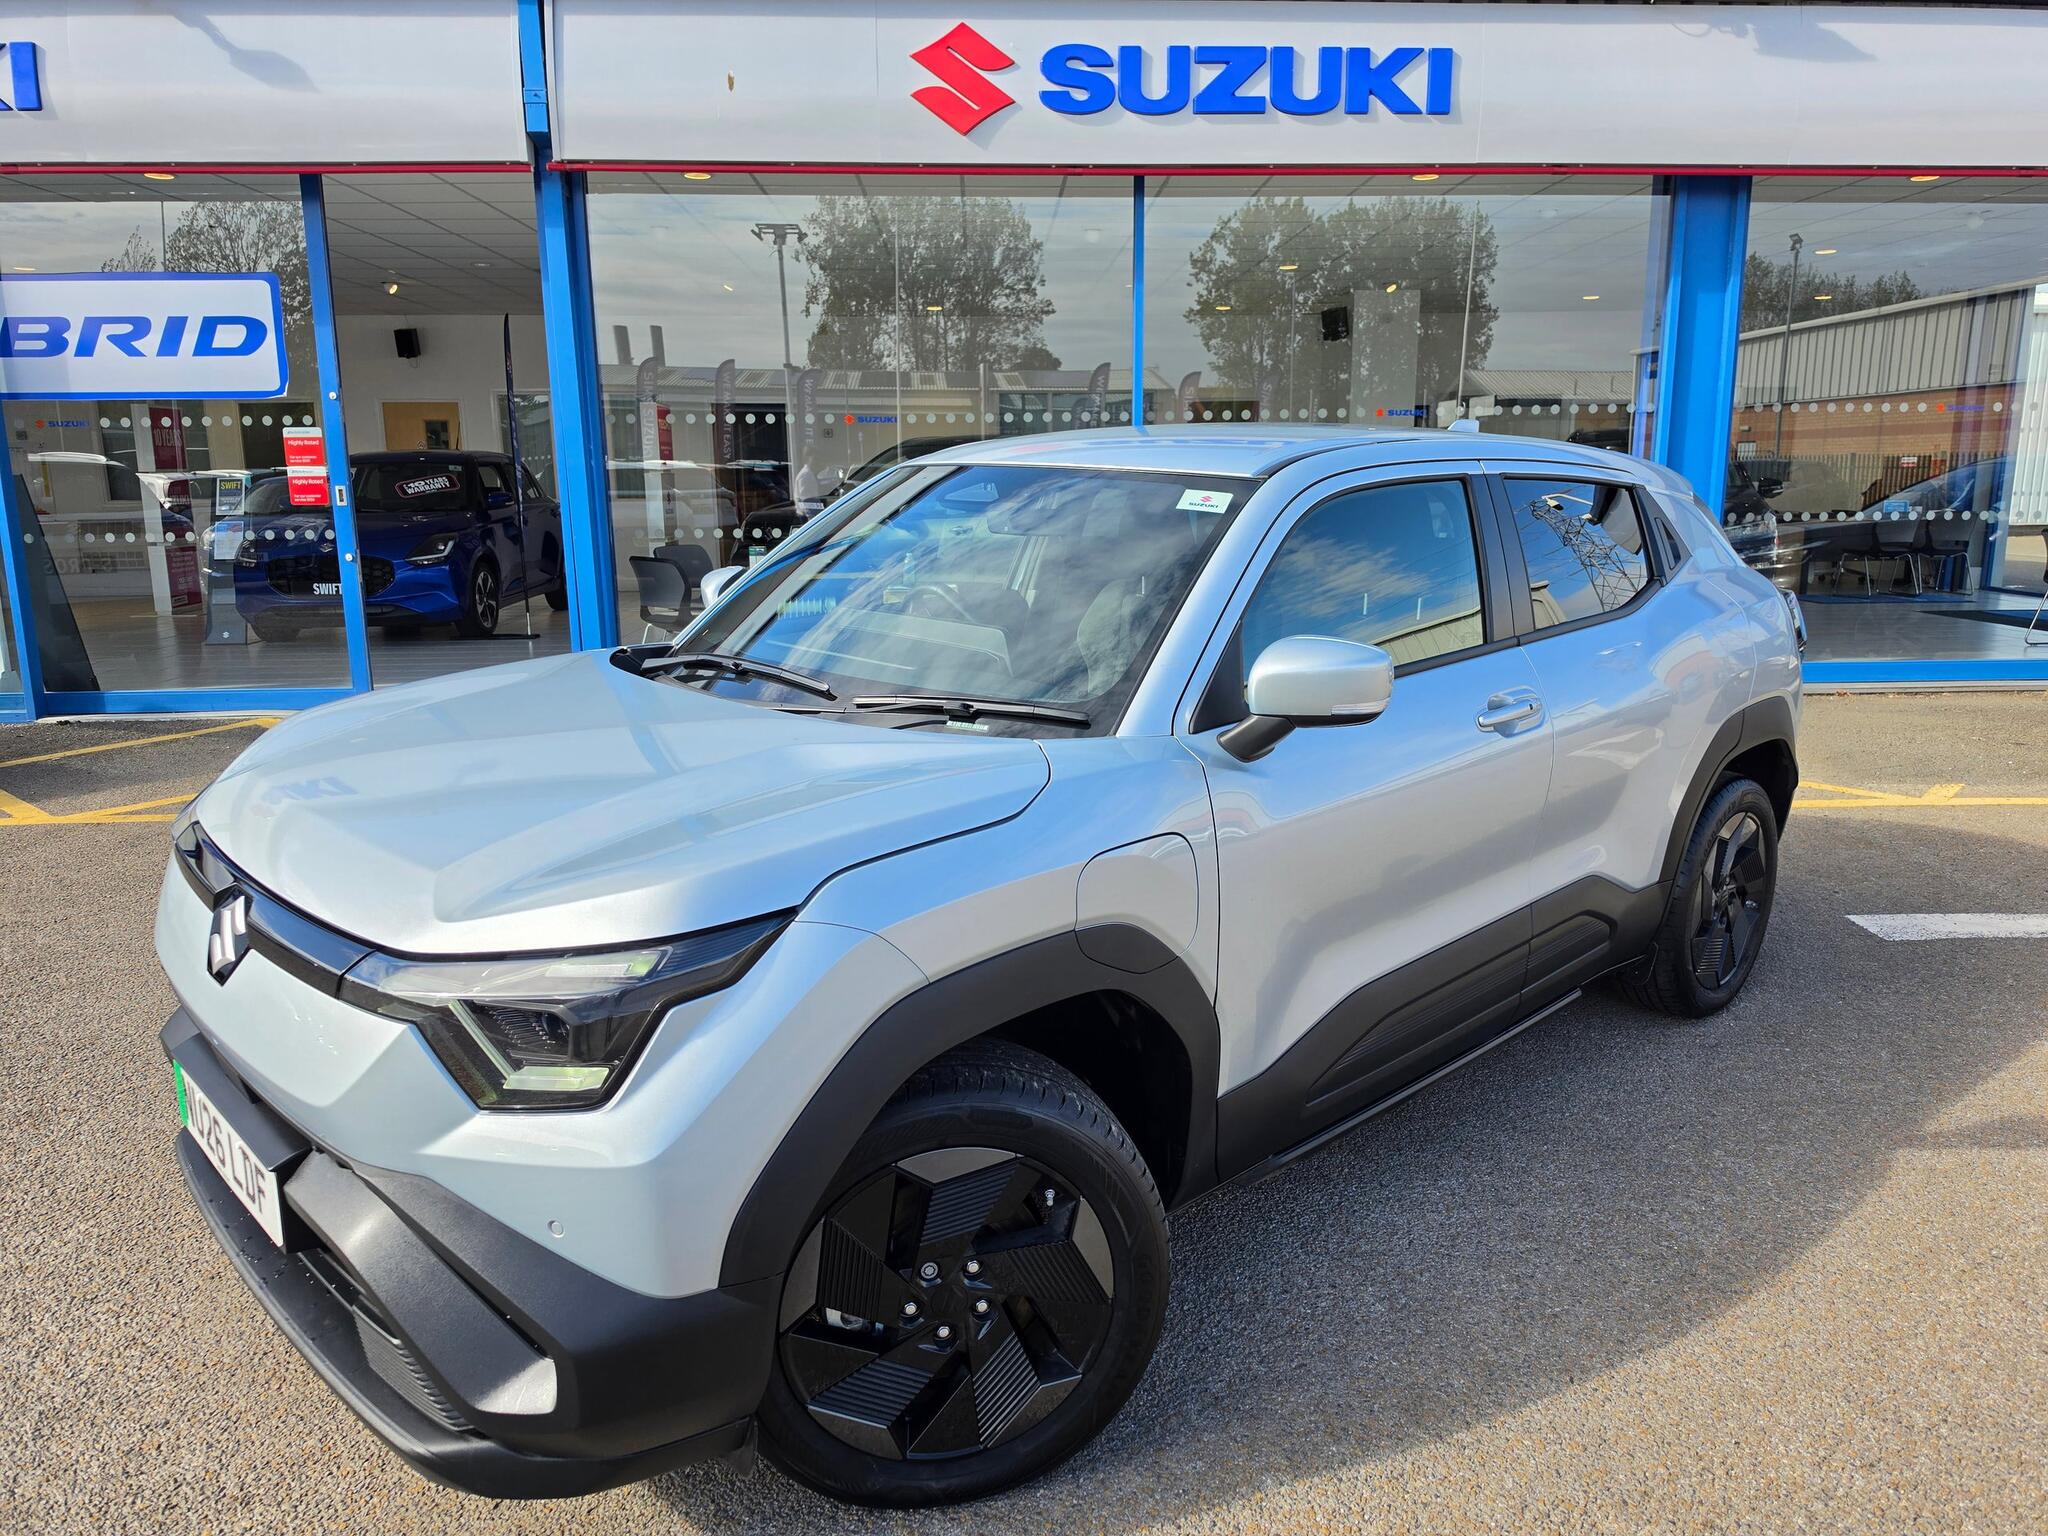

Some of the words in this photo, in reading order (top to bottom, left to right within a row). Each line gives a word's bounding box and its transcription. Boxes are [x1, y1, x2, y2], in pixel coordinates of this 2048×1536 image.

[1038, 43, 1453, 115] SUZUKI
[0, 316, 268, 357] BRID
[1387, 408, 1426, 416] SUZUKI
[857, 415, 898, 423] SUZUKI
[722, 433, 731, 459] EASY
[220, 481, 241, 489] SWIFT
[425, 476, 448, 485] YEARS
[406, 482, 450, 494] WARRANTY
[312, 582, 342, 595] SWIFT
[228, 1132, 266, 1214] LDF
